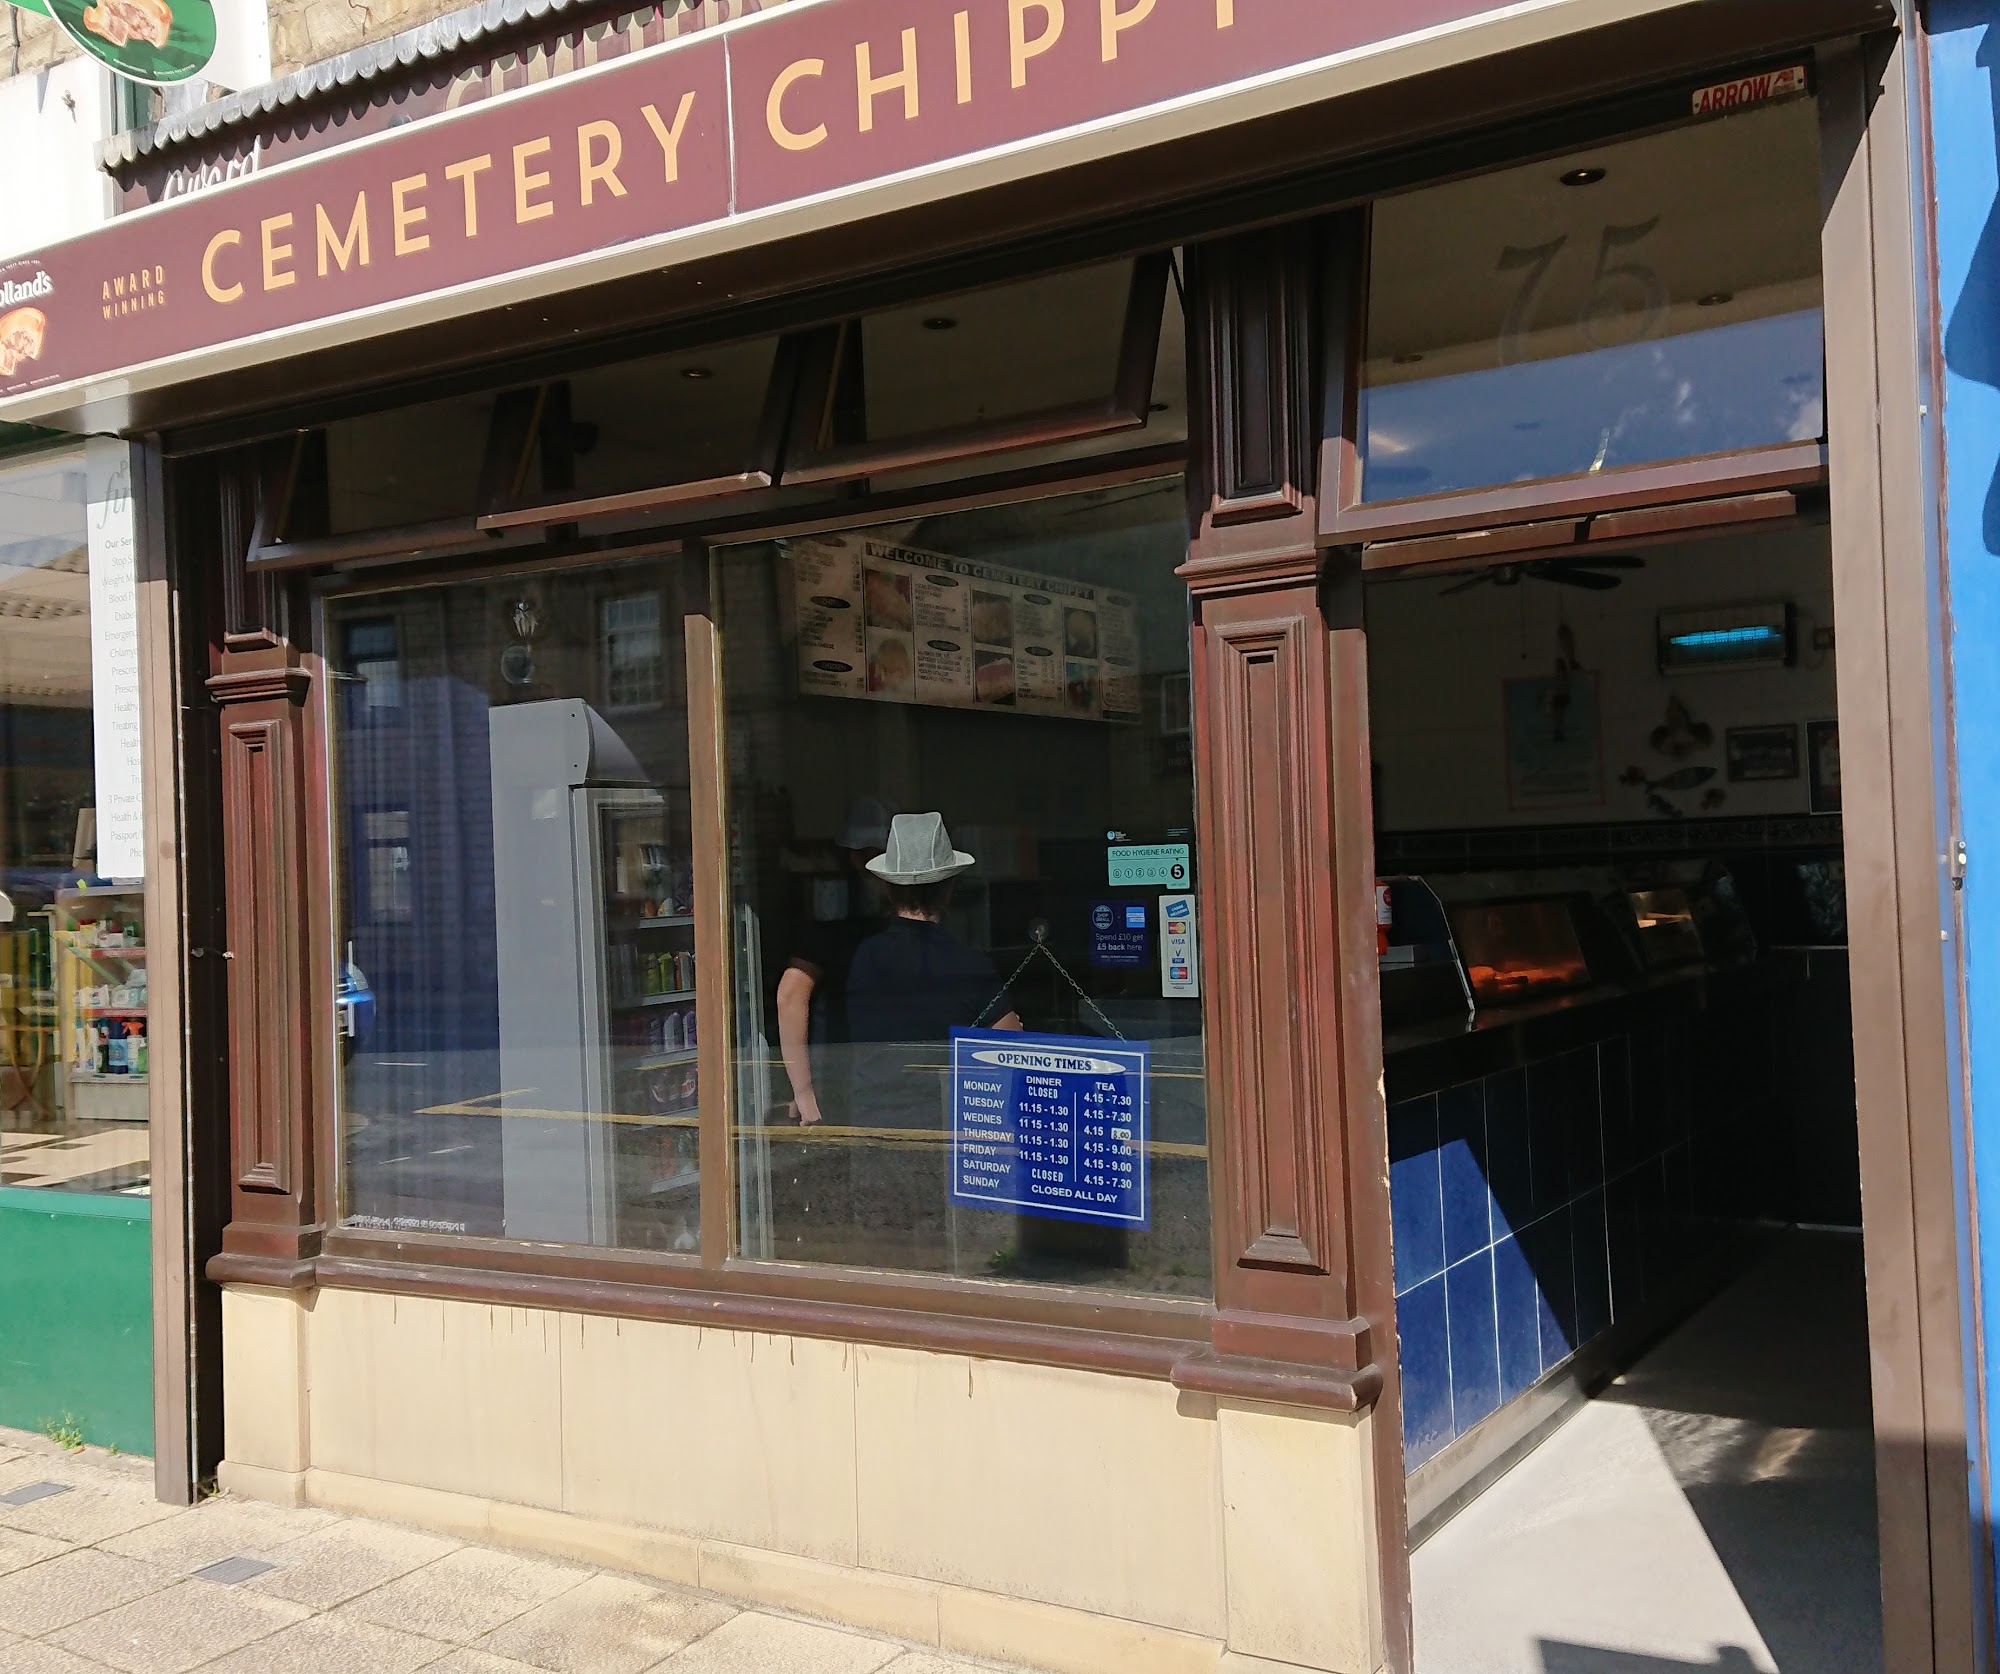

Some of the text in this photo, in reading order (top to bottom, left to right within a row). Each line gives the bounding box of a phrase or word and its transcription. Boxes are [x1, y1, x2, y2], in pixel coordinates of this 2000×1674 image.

[1700, 75, 1771, 112] ARROW
[202, 91, 697, 303] CEMETERY
[102, 265, 164, 300] AWARD
[1496, 216, 1669, 364] 75
[102, 290, 165, 320] WINNING
[105, 540, 118, 549] Our
[112, 557, 127, 568] Stop
[870, 543, 946, 570] WELCOME
[951, 563, 968, 574] TO
[101, 573, 125, 588] Weight
[108, 592, 128, 604] Blood
[112, 721, 138, 732] Treating
[114, 794, 135, 804] Private
[111, 811, 132, 822] Health
[1174, 866, 1182, 878] 5
[1096, 933, 1117, 942] Spend
[1132, 934, 1144, 942] get
[998, 1053, 1091, 1071] OPENING TIMES
[964, 1080, 1002, 1093] MONDAY
[1028, 1087, 1058, 1099] CLOSED
[1084, 1093, 1103, 1103] 4.15
[1112, 1096, 1131, 1106] 7.30
[1026, 1076, 1115, 1092] DINNER TEA
[964, 1096, 1004, 1109] TUESDAY
[1019, 1102, 1042, 1113] 11.15
[1050, 1105, 1068, 1116] 1.30
[1084, 1109, 1103, 1120] 4.15
[1112, 1112, 1131, 1122] 7.30
[963, 1112, 1002, 1125] WEDNES
[1050, 1121, 1068, 1132] 1.30
[1084, 1125, 1103, 1136] 4.15
[963, 1128, 1012, 1141] THURSDAY
[1019, 1135, 1042, 1145] 11.15
[1050, 1137, 1068, 1148] 1.30
[1084, 1142, 1103, 1153] 4.15
[1112, 1145, 1131, 1155] 9.00
[964, 1143, 996, 1156] FRIDAY
[1019, 1151, 1042, 1161] 11.15
[1050, 1153, 1068, 1164] 1.30
[1084, 1158, 1103, 1169] 4.15
[1112, 1161, 1131, 1172] 9.00
[963, 1159, 1011, 1173] SATURDAY
[1032, 1169, 1063, 1183] CLOSED
[1084, 1175, 1103, 1186] 4.15
[1112, 1178, 1131, 1189] 7.30
[963, 1175, 1117, 1203] SUNDAY CLOSED ALL DAY
